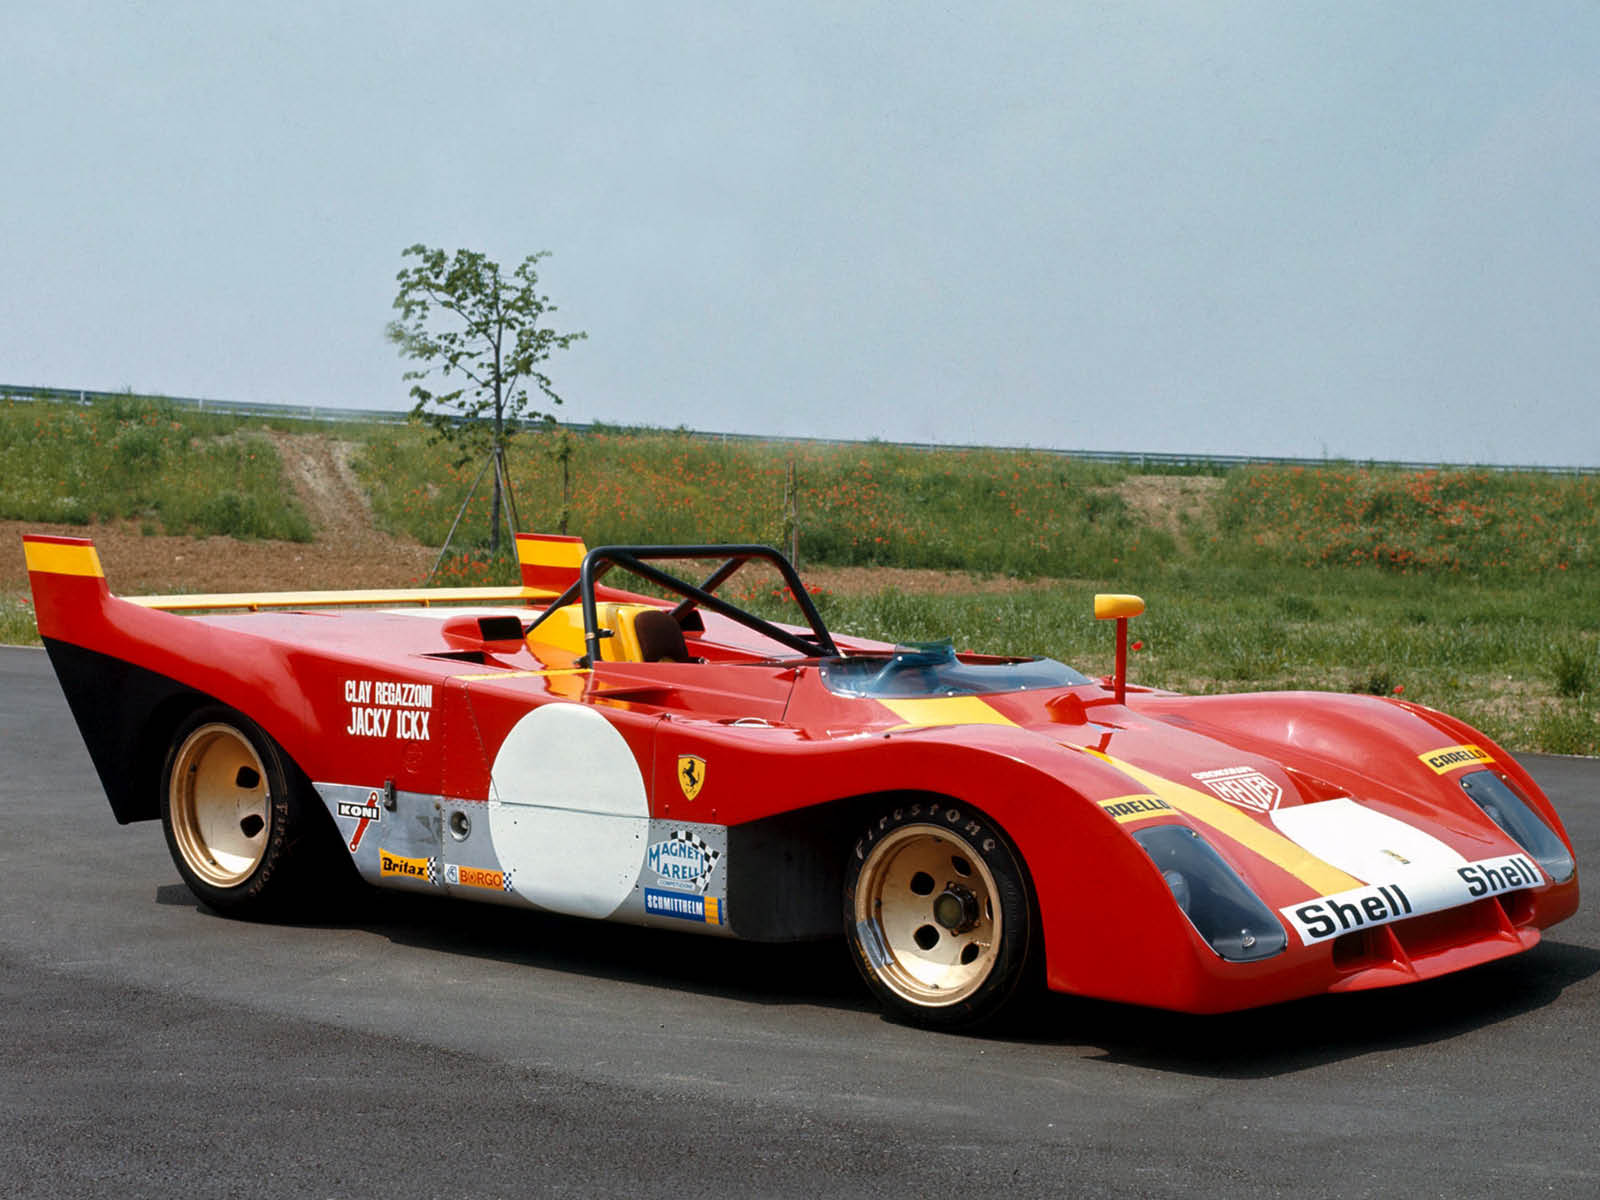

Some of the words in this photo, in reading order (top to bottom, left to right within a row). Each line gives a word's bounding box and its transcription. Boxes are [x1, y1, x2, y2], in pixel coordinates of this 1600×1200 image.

[345, 680, 372, 703] CLAY
[375, 681, 432, 708] REGAZZONI
[347, 707, 391, 737] JACKY
[396, 711, 430, 740] ICKX
[1429, 749, 1487, 768] CARELLO
[1214, 773, 1275, 810] HEUER
[340, 804, 378, 818] KONI
[1104, 799, 1171, 818] ARELLO
[382, 856, 425, 876] Britax
[460, 870, 501, 887] BORGO
[1457, 858, 1539, 898] Shell
[647, 894, 703, 916] SCHMITTHELM
[1295, 884, 1413, 939] Shell
